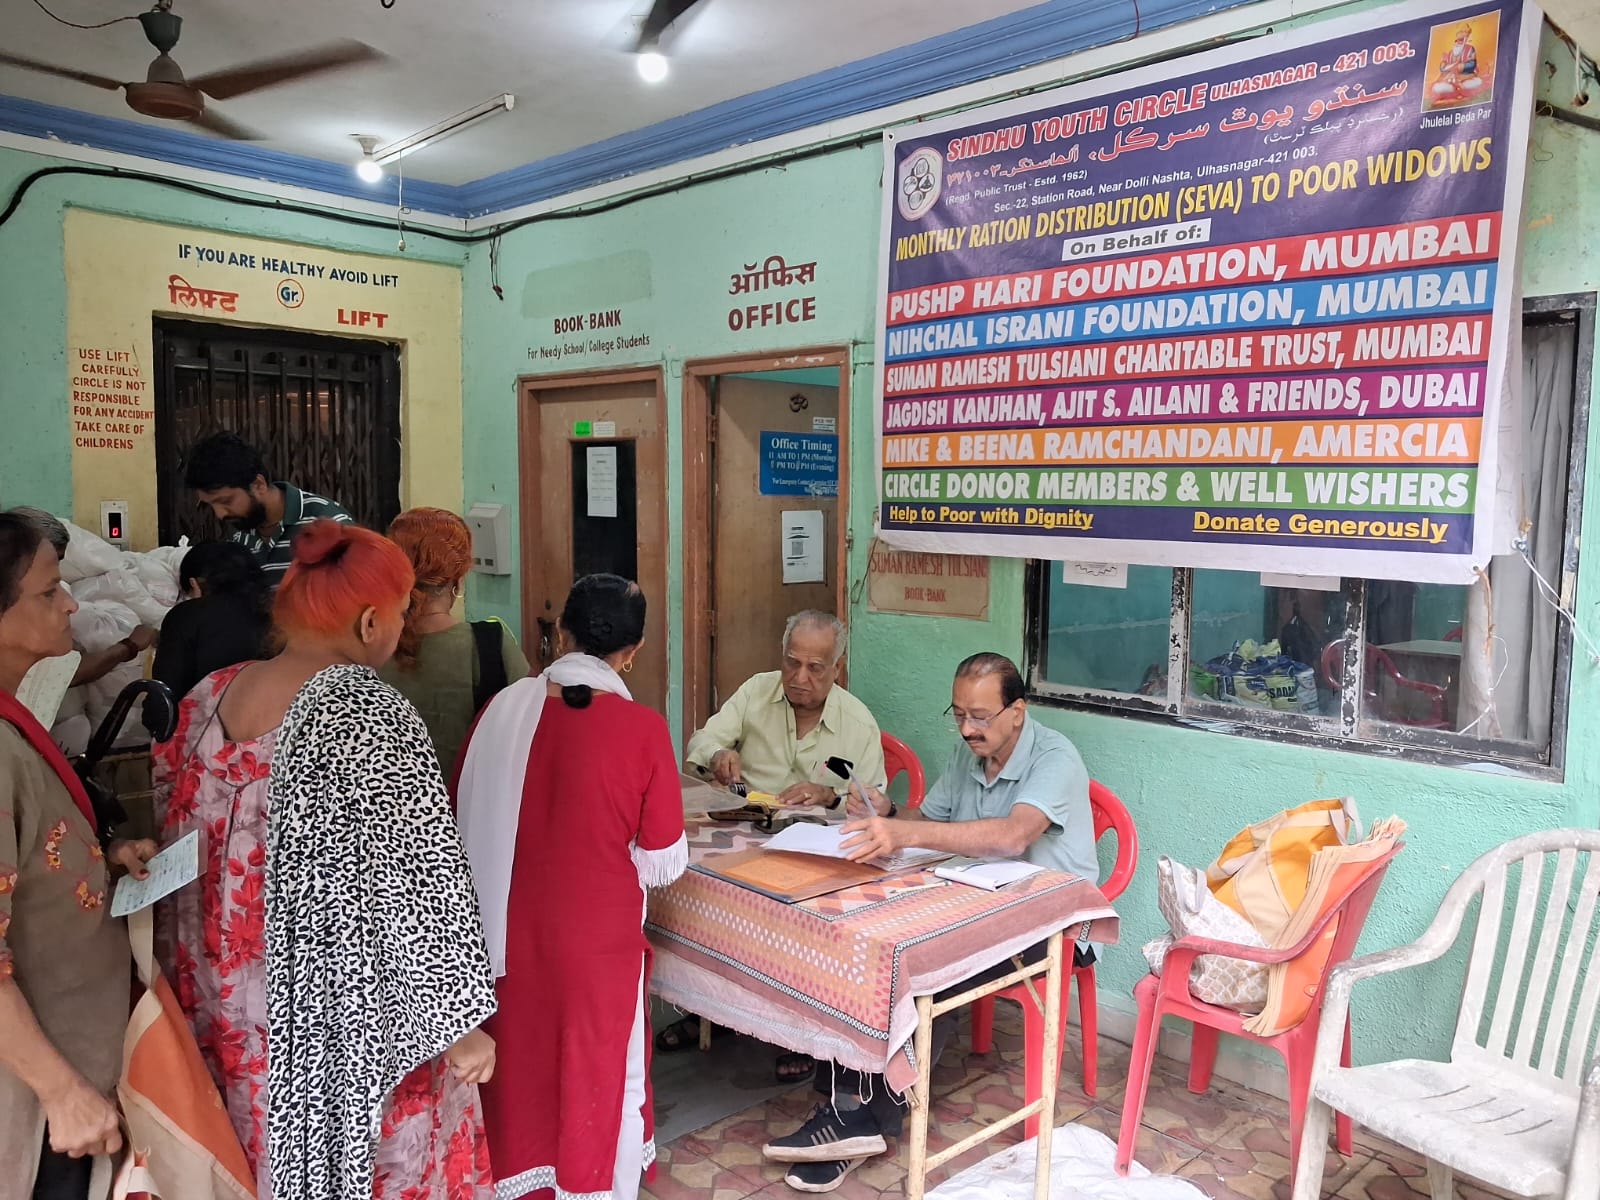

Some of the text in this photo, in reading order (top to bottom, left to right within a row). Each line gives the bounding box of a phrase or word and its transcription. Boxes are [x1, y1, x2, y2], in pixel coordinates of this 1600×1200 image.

[947, 124, 1026, 162] SINDHU
[1033, 106, 1108, 144] YOUTH
[1113, 83, 1208, 125] CIRCLE
[1209, 62, 1317, 101] ULHASNAGAR
[1333, 48, 1368, 73] 421
[1372, 40, 1415, 64] 003.
[1420, 109, 1492, 130] Jhulelal Beda Par
[974, 187, 1001, 199] Public
[1003, 182, 1027, 194] Trust
[1034, 176, 1058, 187] Estd.
[1062, 169, 1088, 181] 1962)
[1031, 188, 1065, 206] Station
[1067, 182, 1095, 201] Road,
[1098, 179, 1124, 195] Near
[1125, 174, 1149, 191] Dolli
[1152, 167, 1194, 185] Nashta,
[1196, 152, 1289, 178] Ulhasnagar-421
[1292, 146, 1318, 161] 003.
[896, 137, 1493, 261] MONTHLY RATION DISTRIBUTION (SEVA) TO POOR WIDOWS
[1070, 227, 1202, 255] On Behalf of:
[178, 243, 399, 288] IF YOU ARE HEALTHY AVOID LIFT
[728, 255, 818, 295] ऑफिस
[890, 218, 1491, 320] PUSHP HARI FOUNDATION, MUMBAI
[168, 274, 239, 313] लिफ्ट
[280, 286, 299, 303] Gr.
[337, 308, 388, 328] LIFT
[554, 309, 622, 334] BOOK-BANK
[728, 296, 817, 332] OFFICE
[888, 269, 1488, 356] NIHCHAL ISRANI FOUNDATION, MUMBAI
[79, 348, 130, 362] USE LIFT
[527, 347, 538, 359] For
[540, 346, 562, 360] Needy
[616, 333, 650, 350] Students
[886, 321, 1483, 393] SUMAN RAMESH TULSIANI CHARITABLE TRUST, MUMBAI
[73, 377, 146, 390] CIRCLE IS NOT
[82, 363, 139, 377] CAREFULLY
[73, 391, 140, 406] RESPONSIBLE
[886, 372, 1480, 428] JAGDISH KANJHAN, AJIT S. AILANI & FRIENDS, DUBAI
[74, 405, 154, 420] FOR ANY ACCIDENT
[75, 421, 144, 434] TAKE CARE OF
[75, 437, 134, 449] CHILDRENS
[772, 437, 833, 453] Office Timing
[776, 451, 786, 460] AM
[885, 422, 1469, 464] MIKE & BEENA RAMCHANDANI, AMERCIA
[776, 461, 786, 469] PM
[801, 462, 810, 470] PM
[885, 471, 1469, 507] CIRCLE DONOR MEMBERS & WELL WISHERS
[889, 506, 1094, 530] Help to Poor with Dignity
[1193, 512, 1448, 543] Donate Generously
[871, 552, 903, 574] SUMAN
[905, 553, 943, 576] RAMESH
